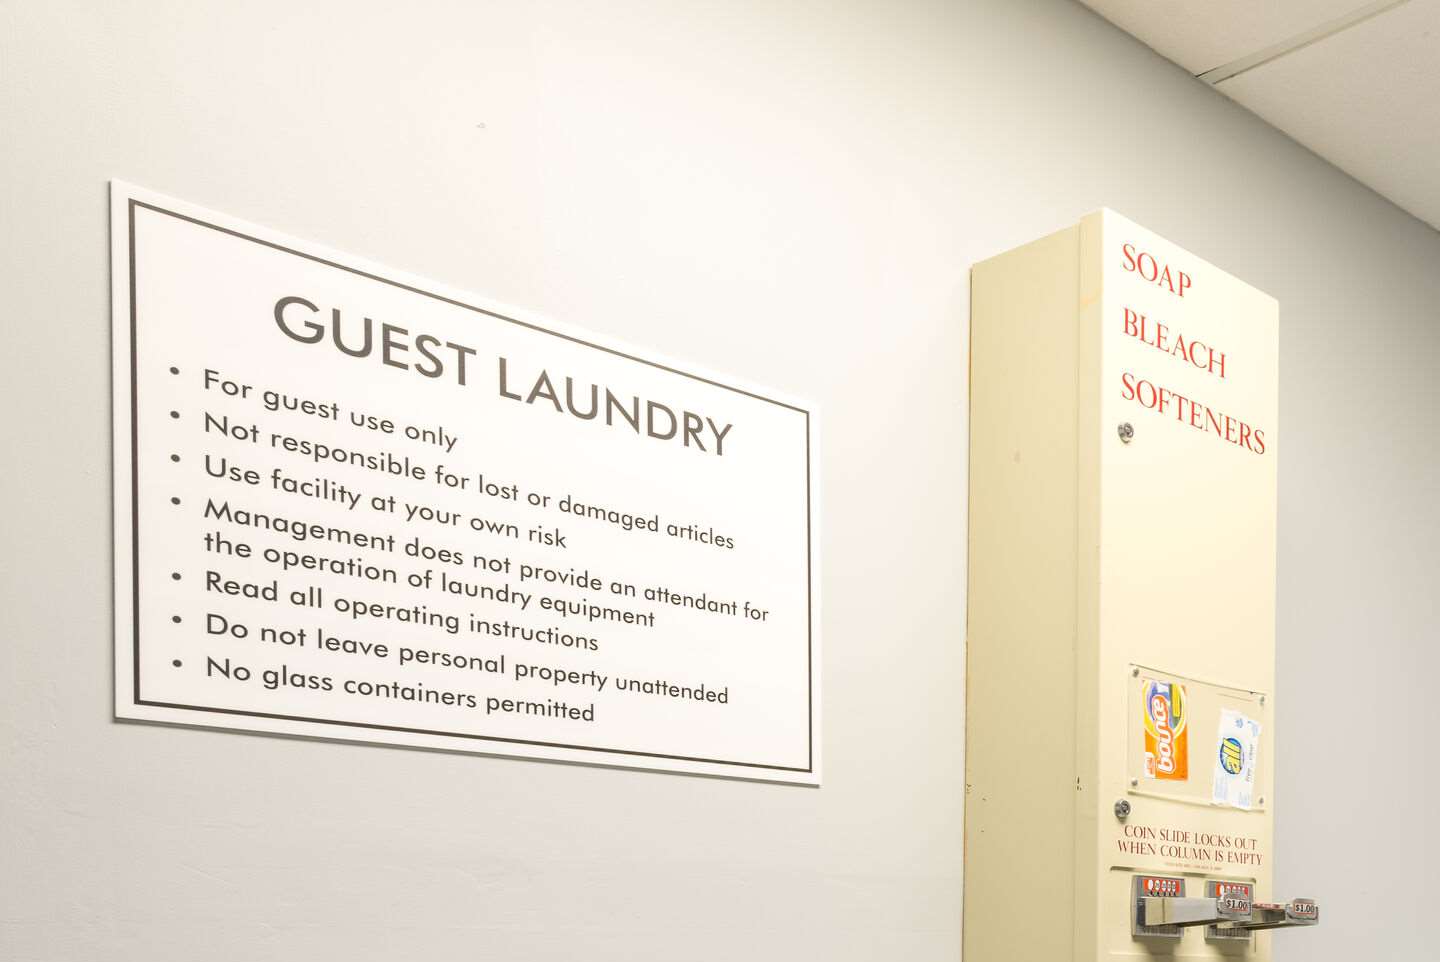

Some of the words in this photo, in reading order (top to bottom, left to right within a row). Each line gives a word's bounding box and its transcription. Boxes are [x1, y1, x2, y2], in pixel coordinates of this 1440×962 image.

[1121, 242, 1192, 298] SOAP
[273, 295, 477, 387] GUEST
[498, 356, 734, 457] LAUNDRY
[1123, 306, 1227, 379] BLEACH
[204, 368, 254, 399] For
[262, 390, 340, 421] guest
[350, 411, 395, 434] use
[404, 425, 458, 454] only
[1121, 371, 1266, 456] SOFTENERS
[204, 411, 260, 444] Not
[271, 433, 427, 481] responsible
[434, 464, 471, 490] for
[479, 473, 519, 502] lost
[527, 492, 552, 508] or
[558, 494, 659, 533] damaged
[666, 524, 734, 550] articles
[204, 454, 261, 486] Use
[270, 468, 362, 511] facility
[370, 495, 397, 513] at
[404, 503, 462, 527] your
[469, 517, 519, 539] own
[528, 524, 567, 549] risk
[203, 497, 396, 553] Management
[404, 536, 464, 566] does
[473, 555, 512, 574] not
[520, 564, 603, 591] provide
[610, 581, 636, 598] an
[643, 586, 738, 617] attendant
[743, 601, 769, 622] for
[203, 530, 252, 559] the
[263, 548, 397, 584] operation
[407, 569, 433, 590] of
[441, 571, 532, 611] laundry
[539, 596, 656, 628] equipment
[205, 570, 278, 602] Read
[289, 585, 323, 609] all
[333, 598, 460, 635] operating
[469, 612, 599, 652] instructions
[206, 612, 249, 639] Do
[260, 627, 307, 647] not
[317, 627, 389, 658] leave
[399, 647, 505, 674] personal
[515, 663, 608, 693] property
[615, 677, 729, 705] unattended
[207, 655, 251, 682] No
[262, 664, 334, 692] glass
[343, 680, 477, 709] containers
[486, 697, 595, 722] permitted
[1152, 697, 1173, 774] bounce
[1117, 839, 1157, 855] WHEN
[1160, 845, 1212, 861] COLUMN
[1214, 849, 1225, 863] IS
[1227, 851, 1264, 866] EMPTY
[1124, 824, 1157, 840] COIN
[1159, 828, 1191, 844] SLIDE
[1194, 832, 1232, 848] LOCKS
[1234, 837, 1258, 851] OUT
[1225, 899, 1248, 910] $1.00
[1294, 903, 1315, 914] $1.00
